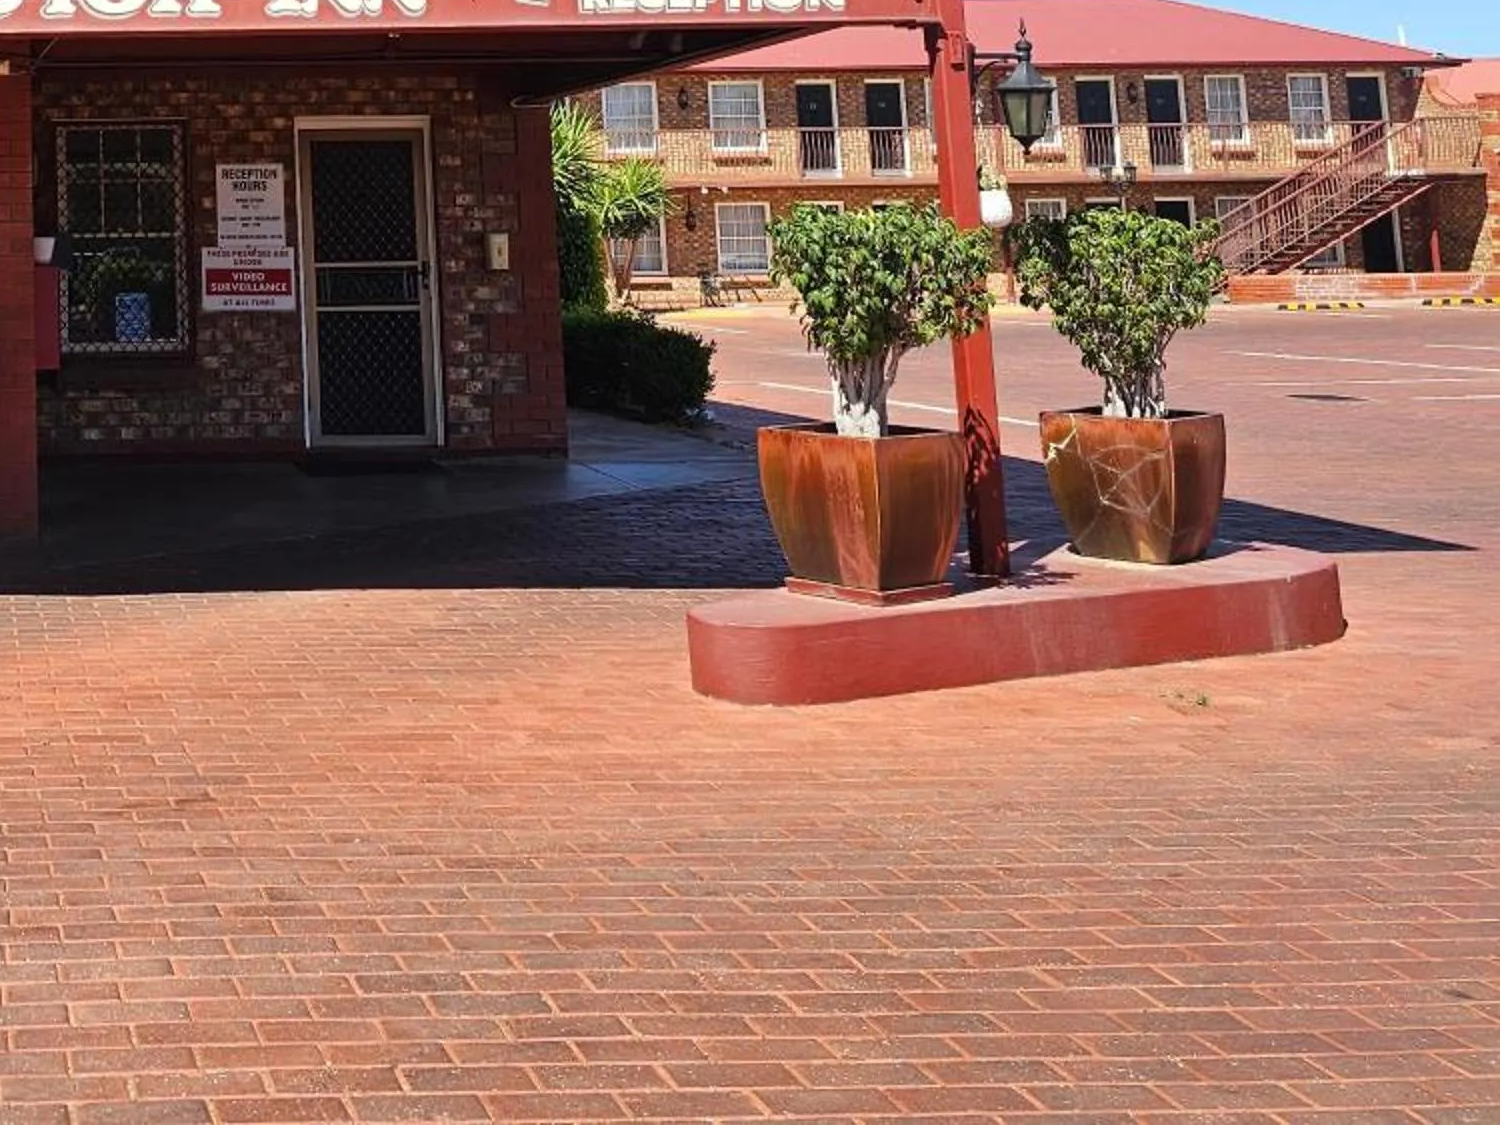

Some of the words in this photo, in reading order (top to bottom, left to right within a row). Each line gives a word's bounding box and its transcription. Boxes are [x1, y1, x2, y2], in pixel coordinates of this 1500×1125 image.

[221, 168, 278, 180] RECEPTION
[232, 180, 268, 192] HOURS
[231, 272, 265, 282] VIDEO
[211, 282, 288, 292] SURVEILLANCE
